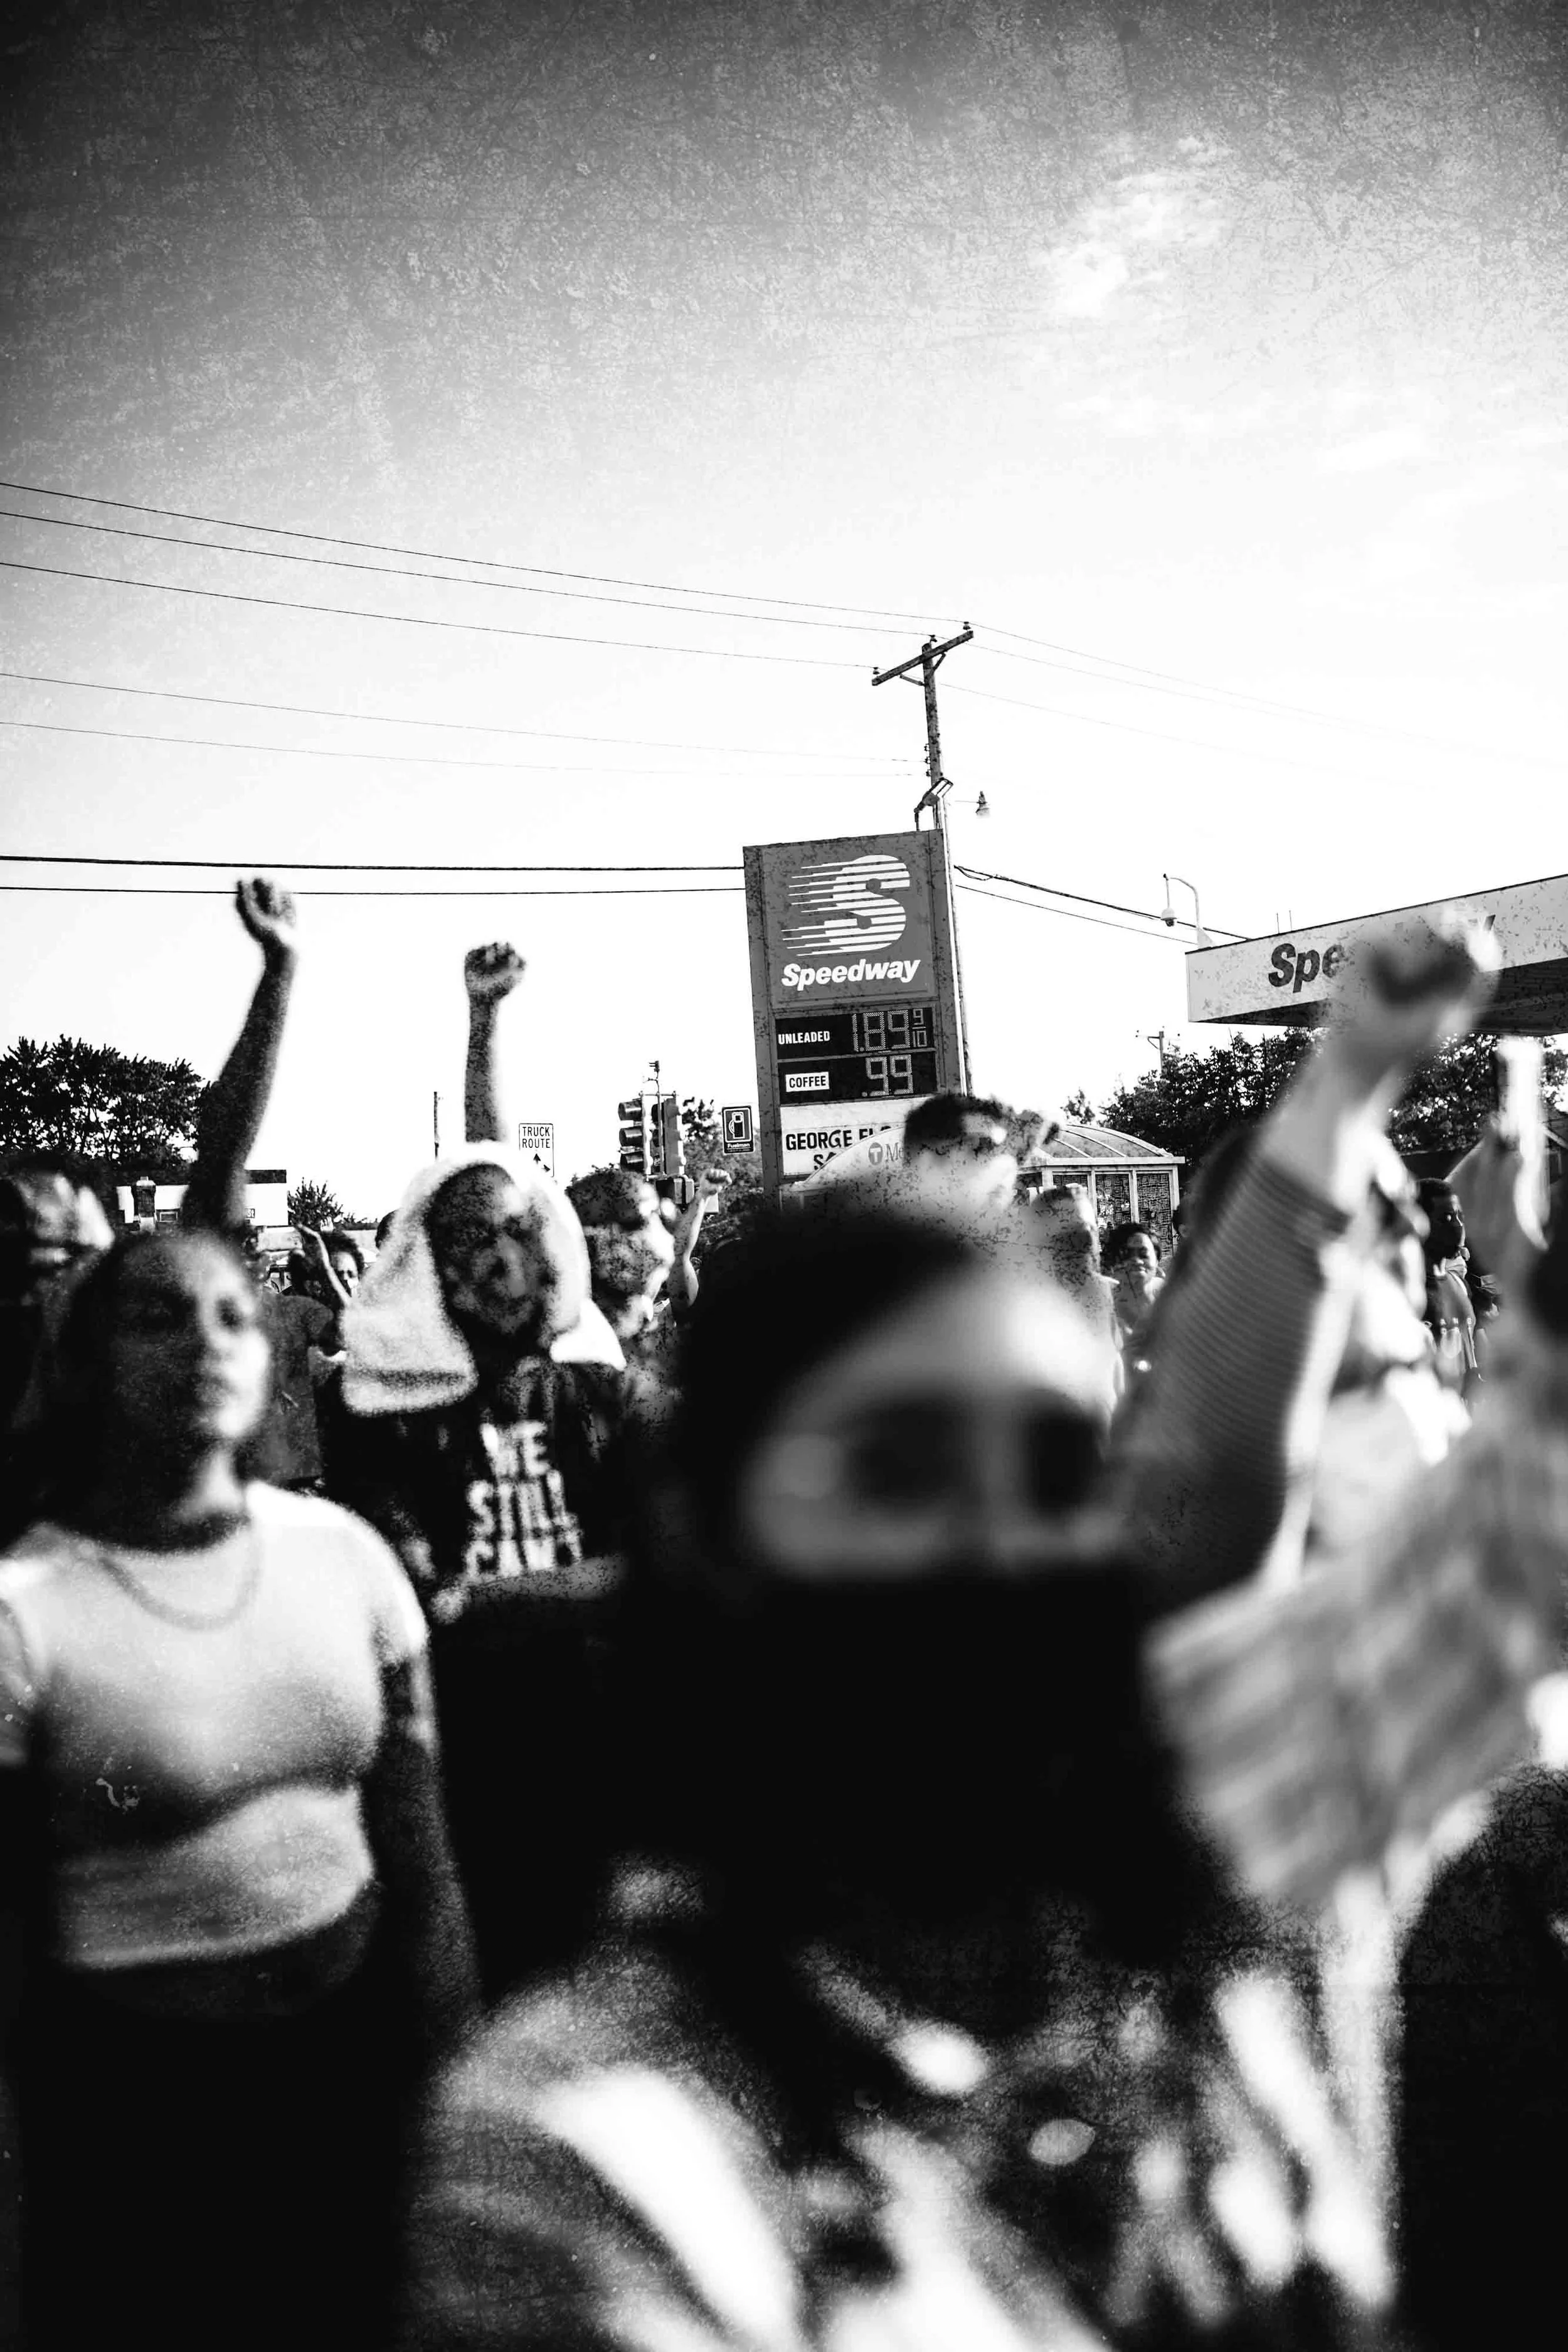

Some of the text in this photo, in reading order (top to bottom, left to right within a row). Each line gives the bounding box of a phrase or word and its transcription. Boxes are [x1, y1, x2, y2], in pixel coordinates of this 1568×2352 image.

[781, 959, 921, 991] Speedway
[778, 1030, 830, 1045] UNLEADED
[789, 1076, 827, 1088] COFFEE
[522, 1126, 550, 1136] TRUCK
[522, 1138, 551, 1148] ROUTE
[786, 1130, 853, 1150] GEORGE
[479, 1419, 552, 1476] WE
